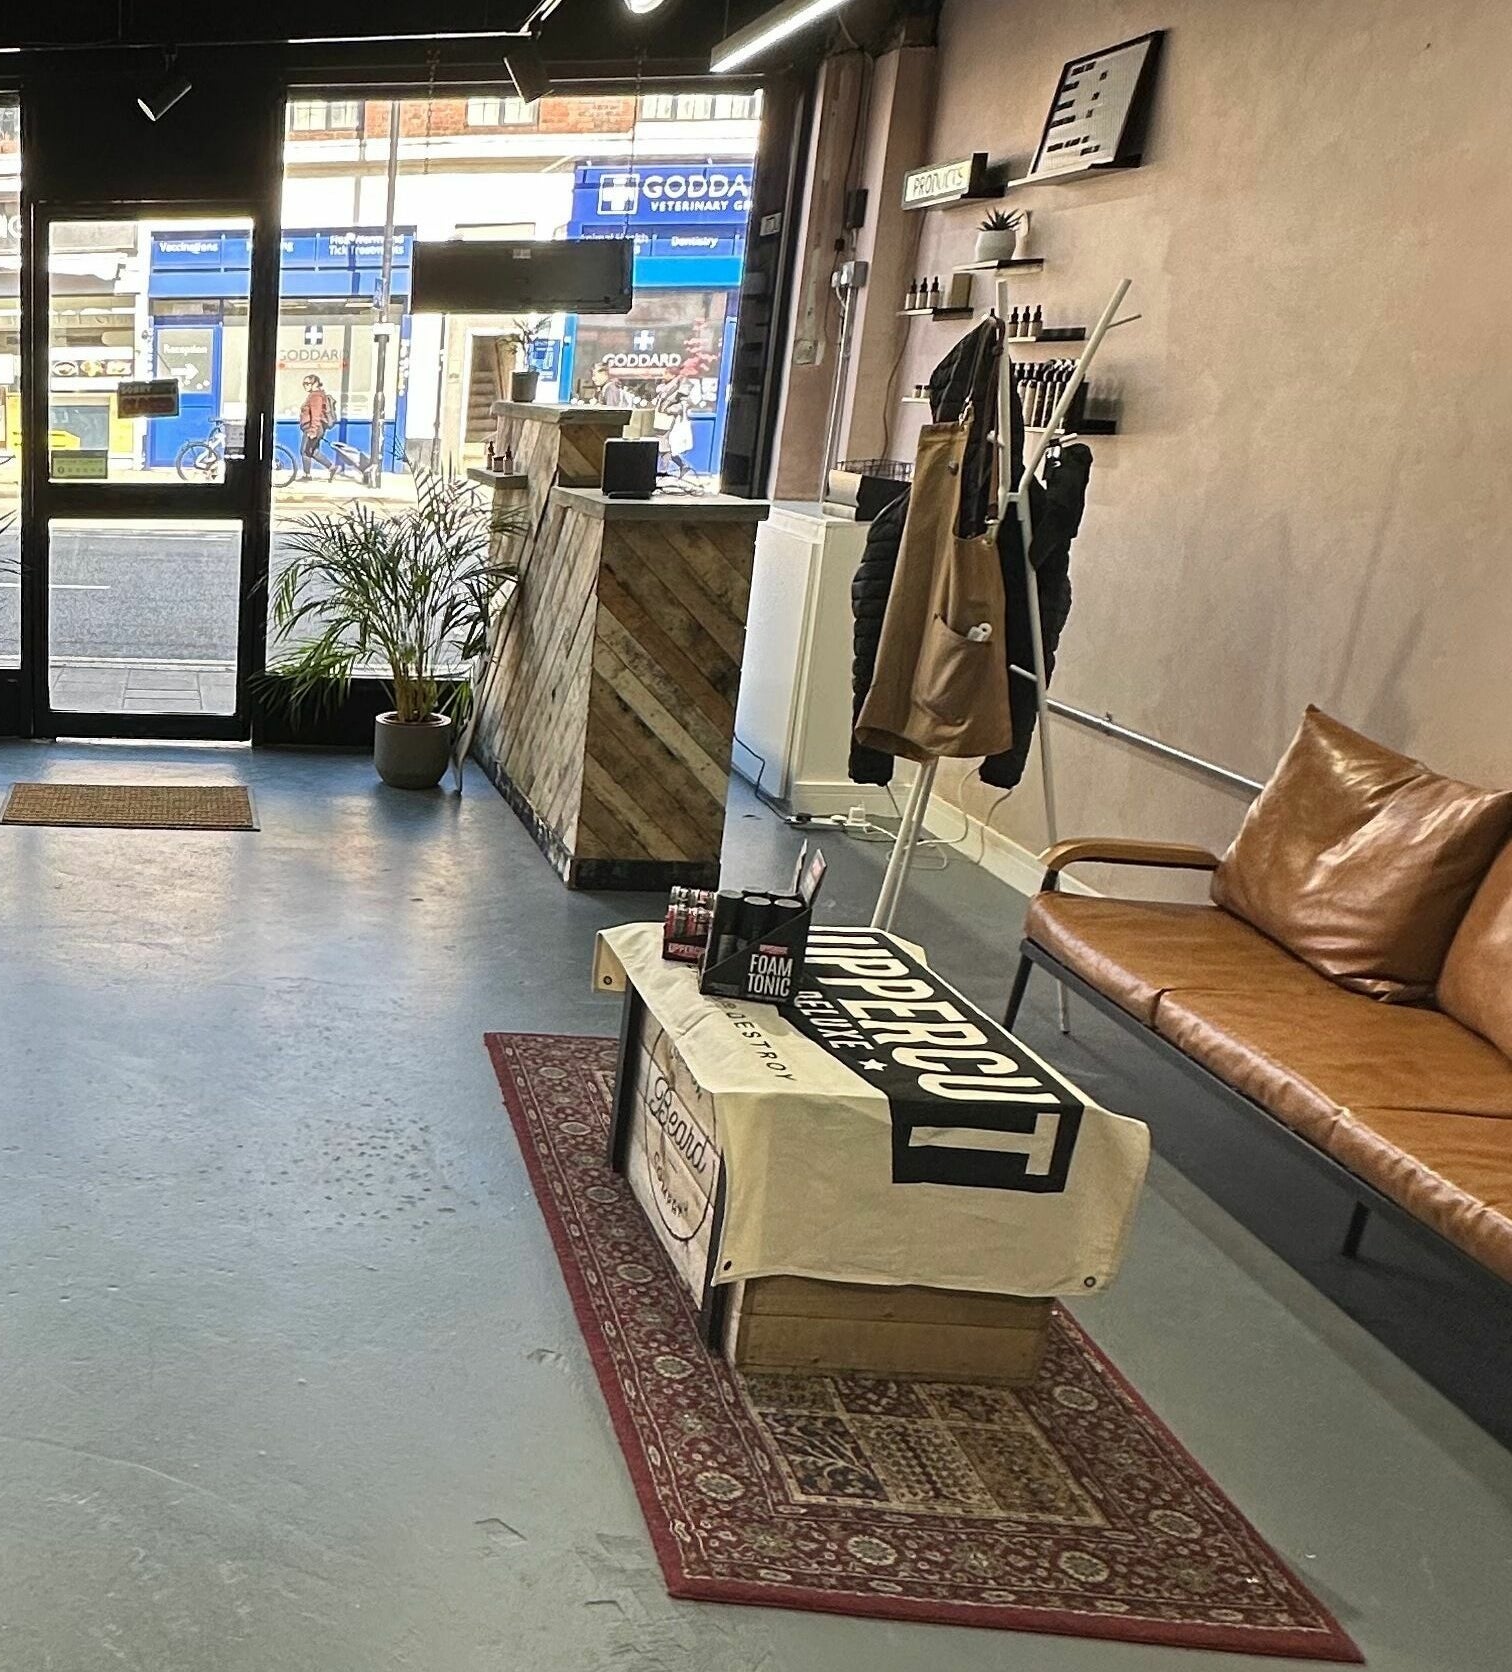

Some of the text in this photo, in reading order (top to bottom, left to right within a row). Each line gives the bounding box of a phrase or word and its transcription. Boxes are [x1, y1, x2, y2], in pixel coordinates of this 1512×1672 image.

[651, 200, 729, 213] VETERINARY
[602, 353, 682, 368] GODDARD
[749, 953, 794, 977] FOAM
[747, 973, 792, 997] TONIC
[726, 1012, 798, 1082] DESTROY
[650, 1076, 708, 1175] Beard
